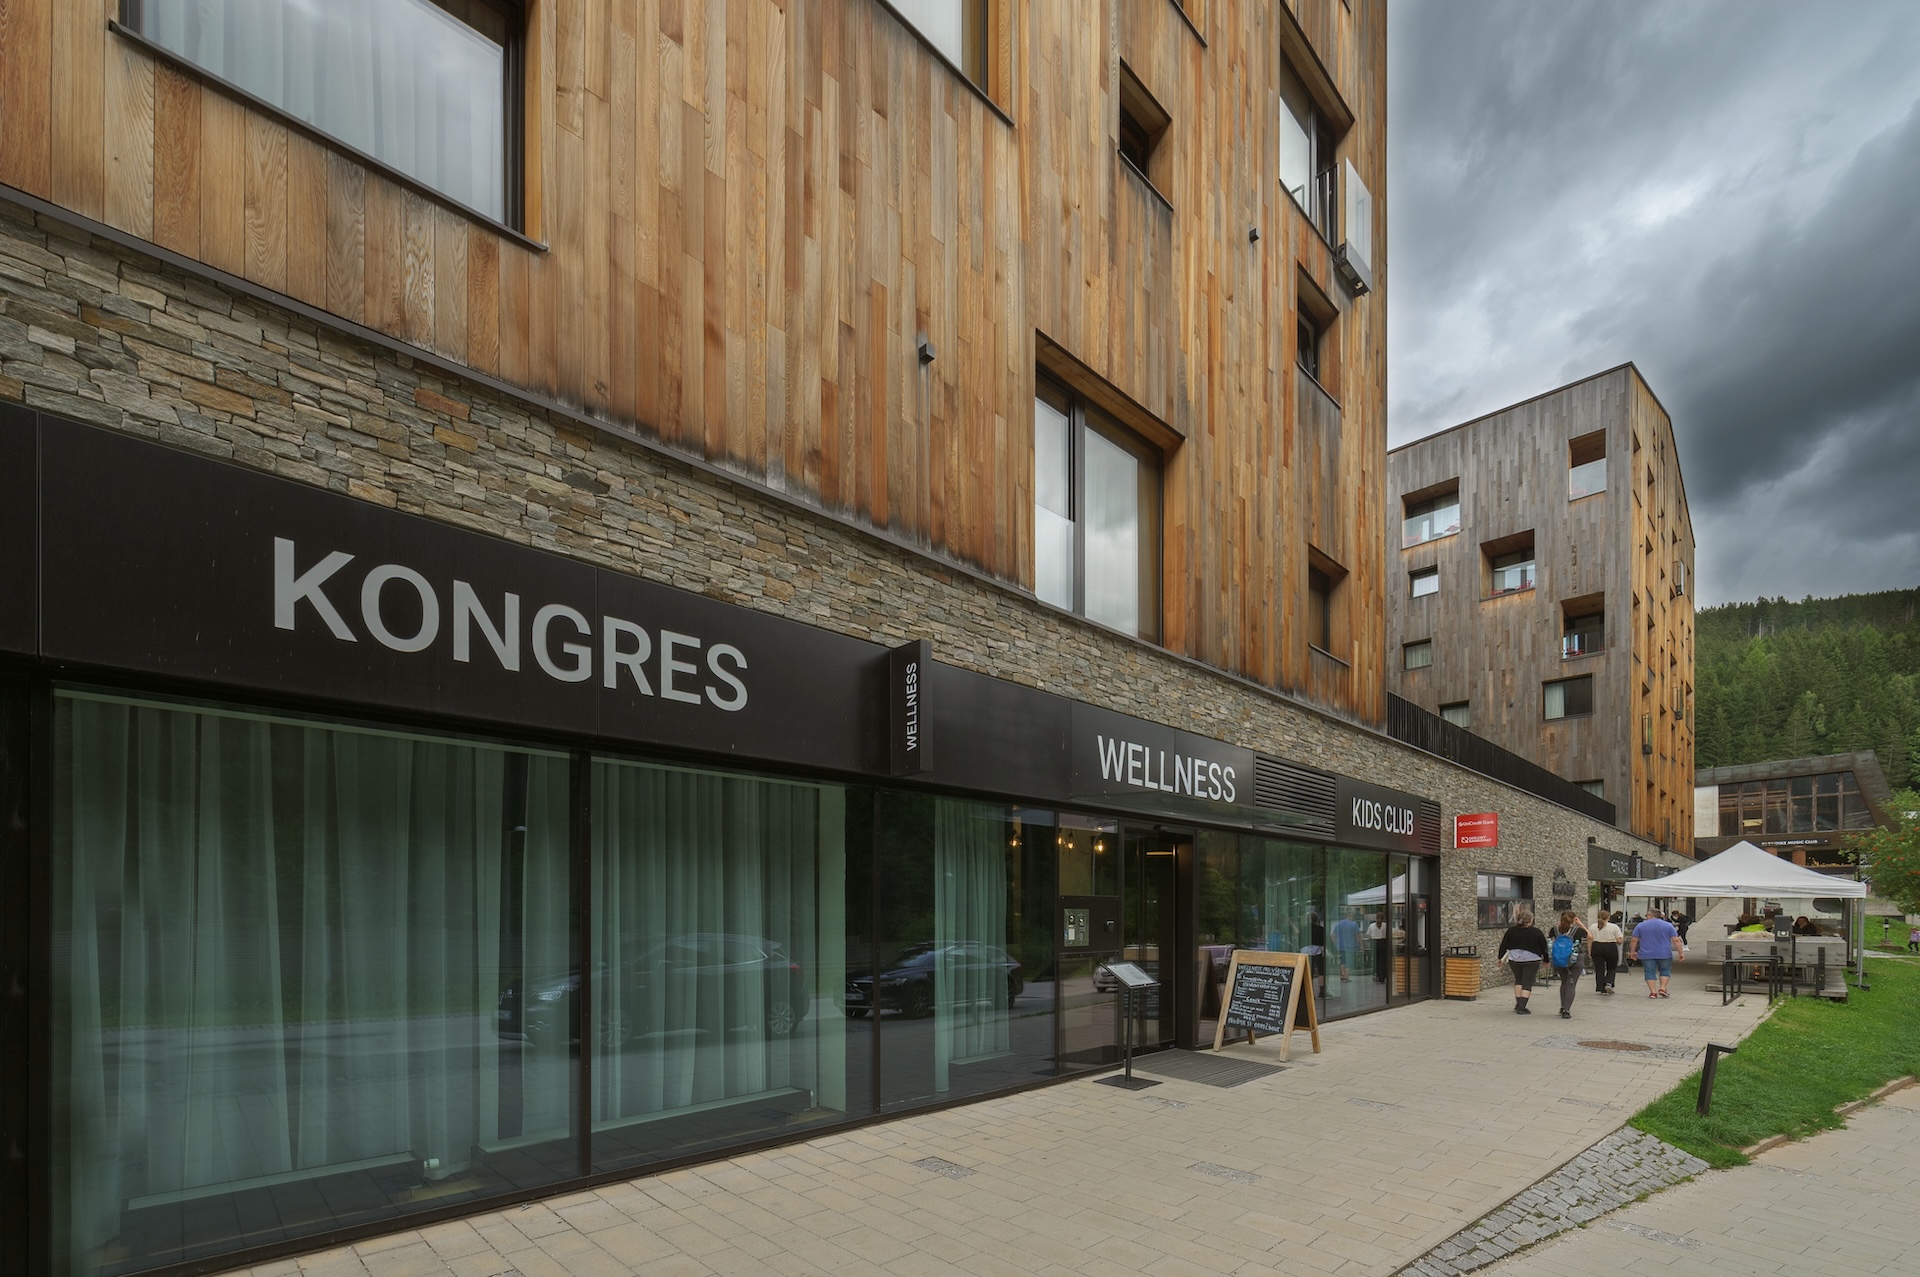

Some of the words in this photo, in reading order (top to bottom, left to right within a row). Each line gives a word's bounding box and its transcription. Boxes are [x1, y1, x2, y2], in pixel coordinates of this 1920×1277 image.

[274, 536, 749, 712] KONGRES
[905, 661, 918, 752] WELLNESS
[1097, 734, 1237, 804] WELLNESS
[1351, 796, 1383, 830] KIDS
[1384, 805, 1415, 836] CLUB
